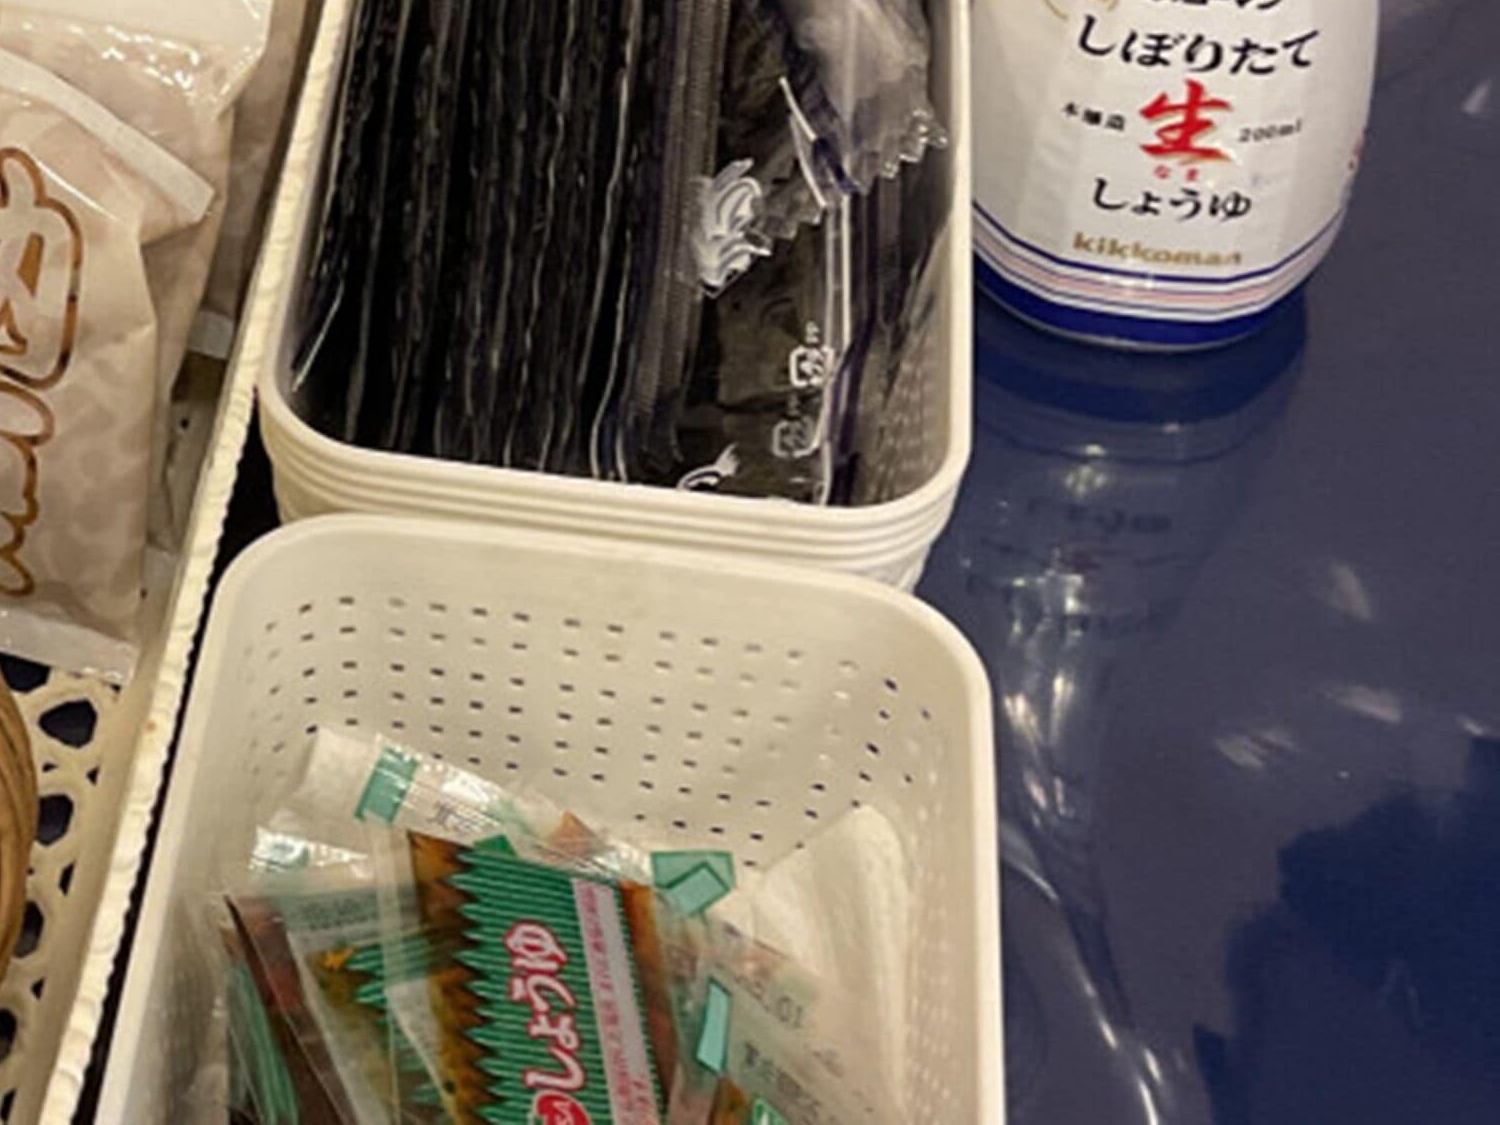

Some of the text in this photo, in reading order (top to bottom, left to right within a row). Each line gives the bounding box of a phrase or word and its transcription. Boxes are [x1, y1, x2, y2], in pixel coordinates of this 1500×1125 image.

[1077, 14, 1320, 75] しぼりたて
[1139, 79, 1234, 164] 生
[1237, 118, 1303, 145] 200ml
[1092, 177, 1252, 223] しょうゆ
[1072, 231, 1243, 266] kikkoman
[502, 920, 587, 1090] しょうゆ
